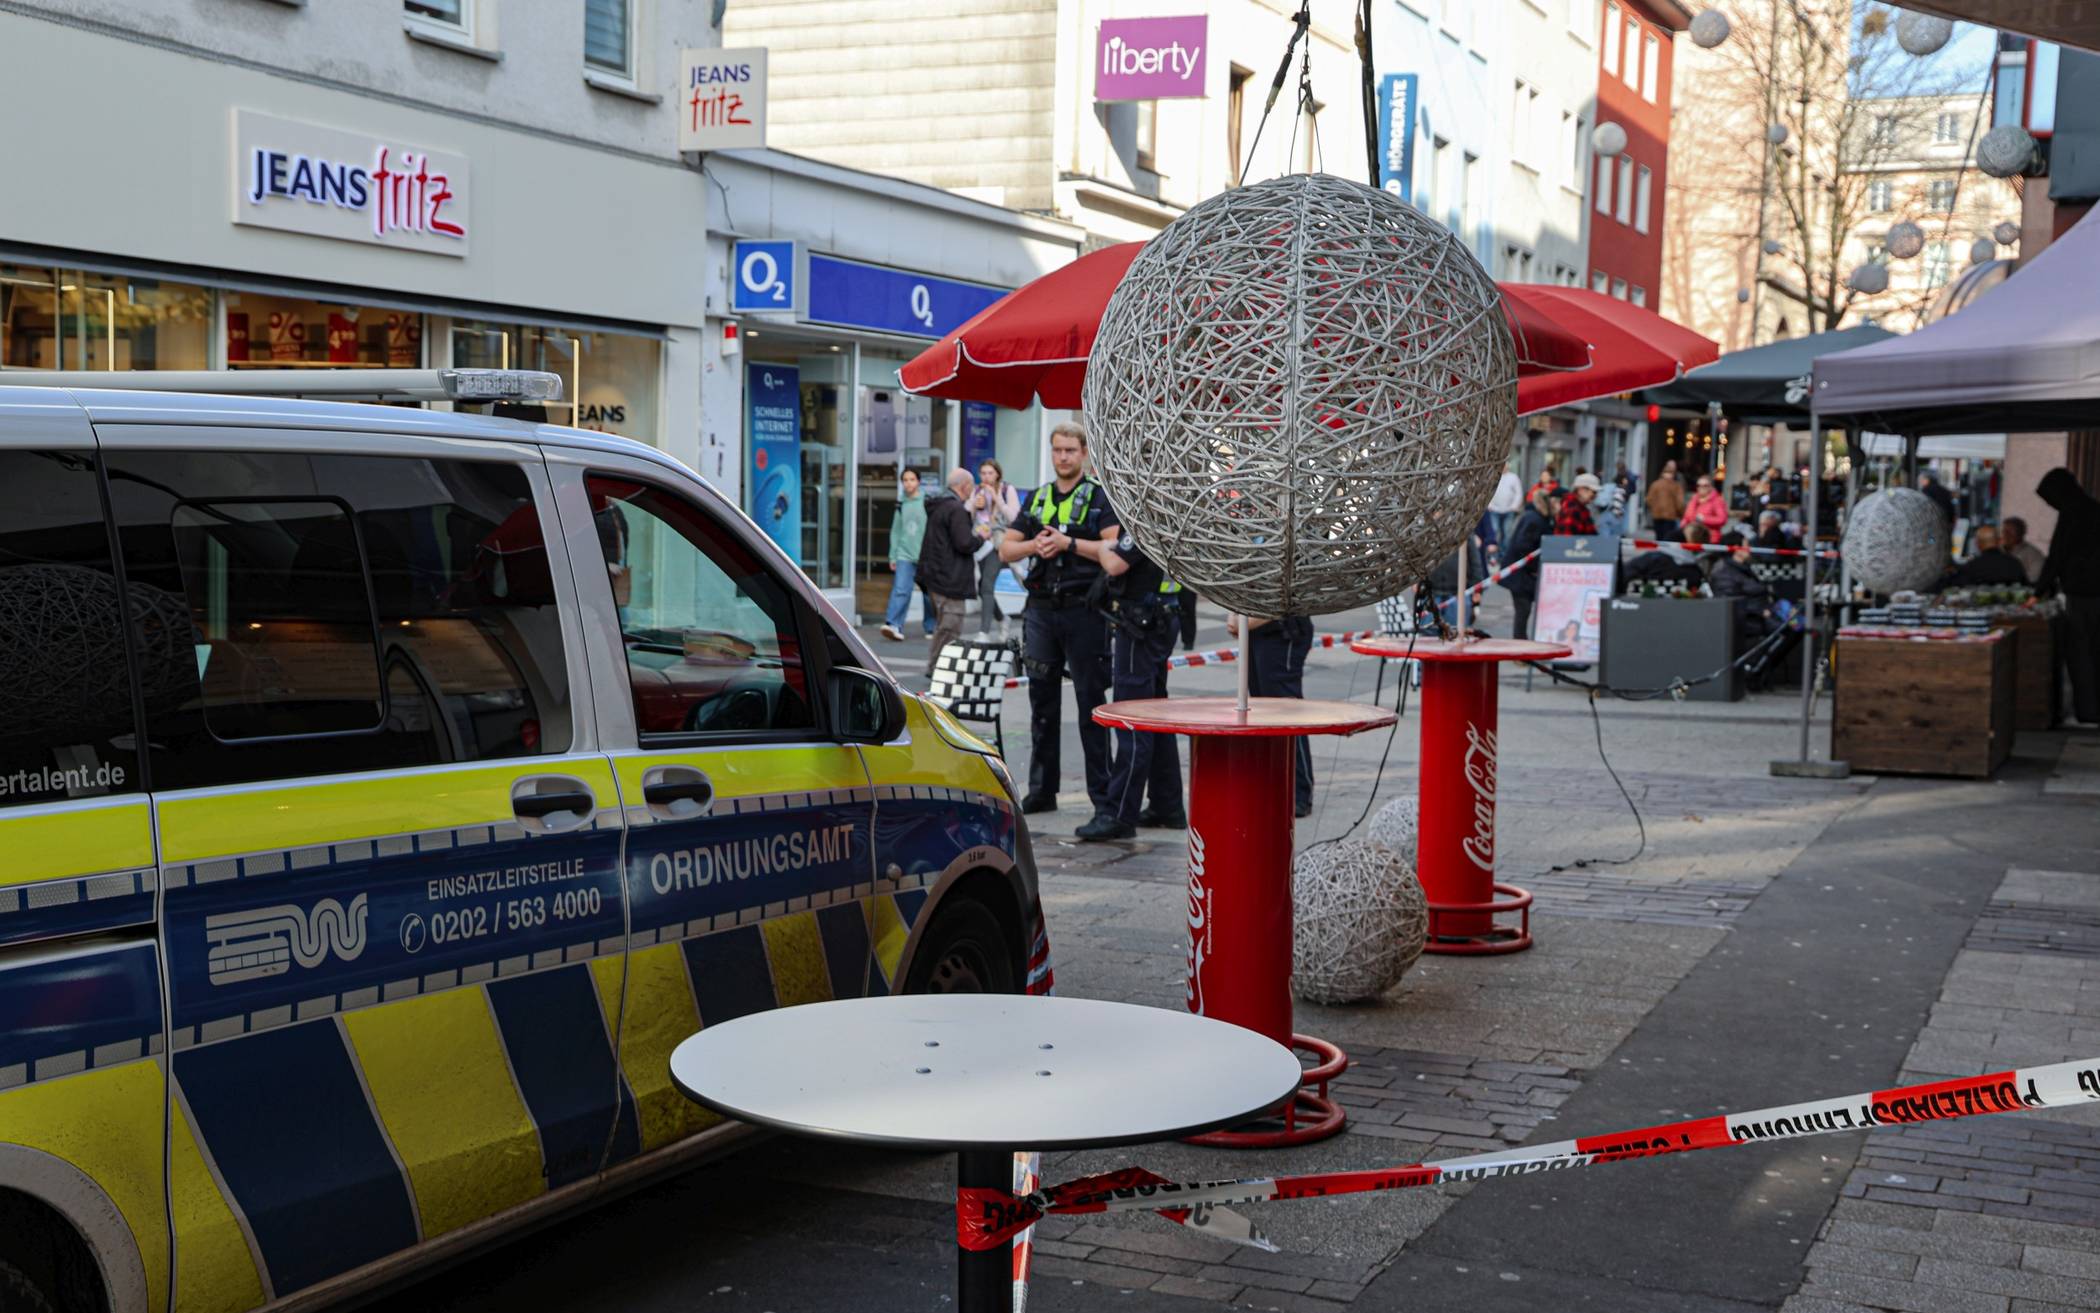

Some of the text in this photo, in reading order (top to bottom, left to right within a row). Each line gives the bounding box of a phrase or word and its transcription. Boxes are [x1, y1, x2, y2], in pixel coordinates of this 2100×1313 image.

[690, 64, 751, 88] JEANS
[1103, 36, 1200, 80] liberty
[689, 87, 752, 133] fritz
[754, 405, 795, 418] SCHNELLES
[754, 419, 794, 432] INTERNET
[427, 858, 585, 900] EINSATZLEITSTELLE
[651, 823, 855, 895] ORDNUNGSAMT
[431, 906, 488, 944] 0202
[507, 896, 546, 930] 563
[552, 887, 600, 920] 4000
